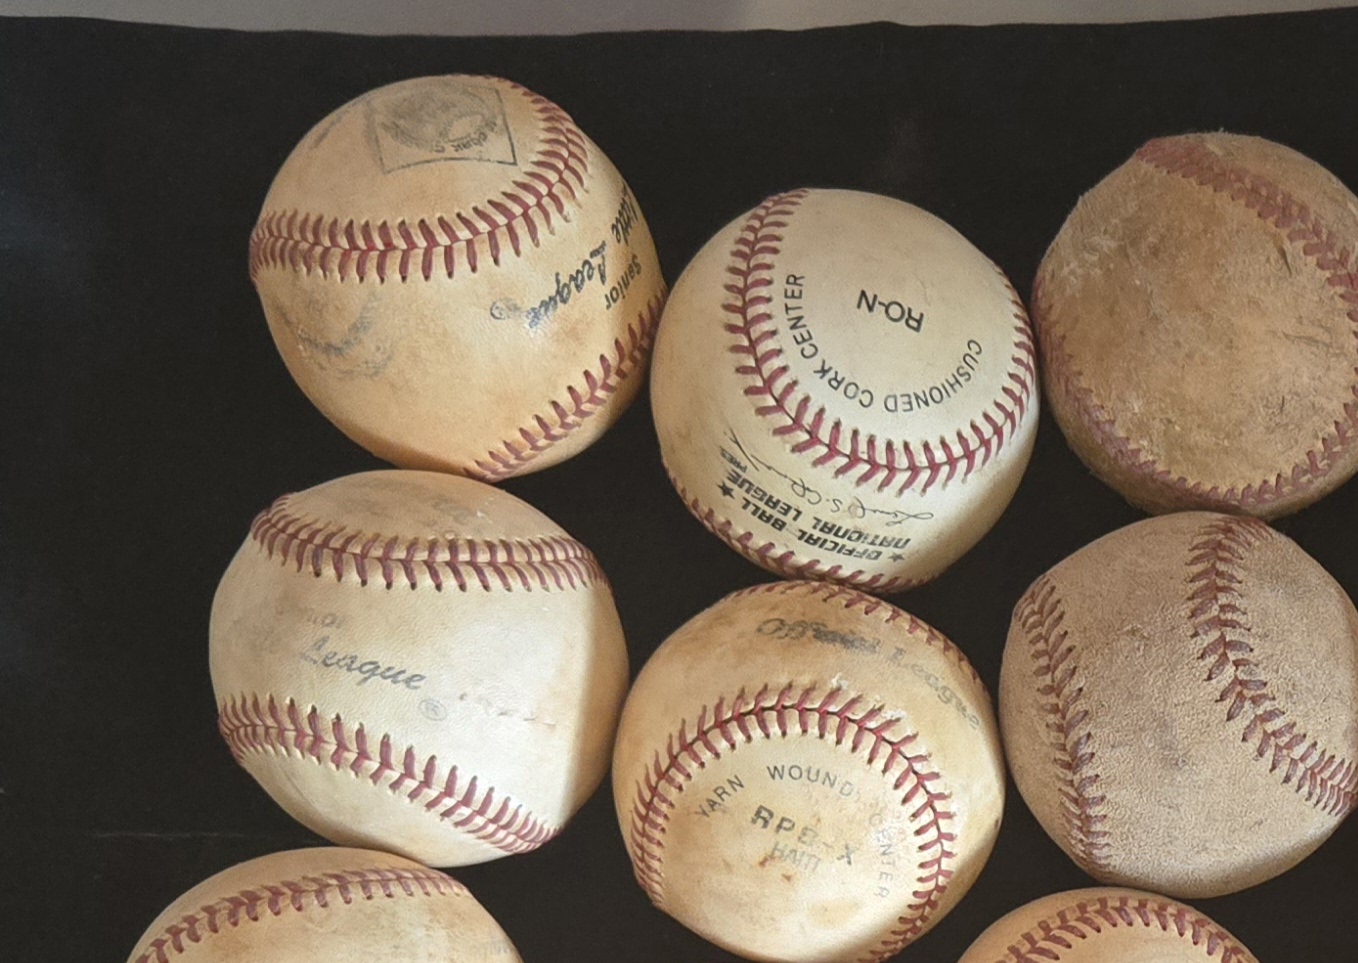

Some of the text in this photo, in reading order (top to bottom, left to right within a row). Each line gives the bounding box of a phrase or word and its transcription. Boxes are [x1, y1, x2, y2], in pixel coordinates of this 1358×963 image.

[784, 273, 983, 413] CUSHIONED CORK CENTER
[856, 289, 924, 333] RO-N
[725, 468, 912, 550] NATIONAL LEAGUE
[741, 496, 883, 561] OFFICIAL BALL
[695, 775, 746, 819] YARN
[766, 764, 853, 798] WOUND
